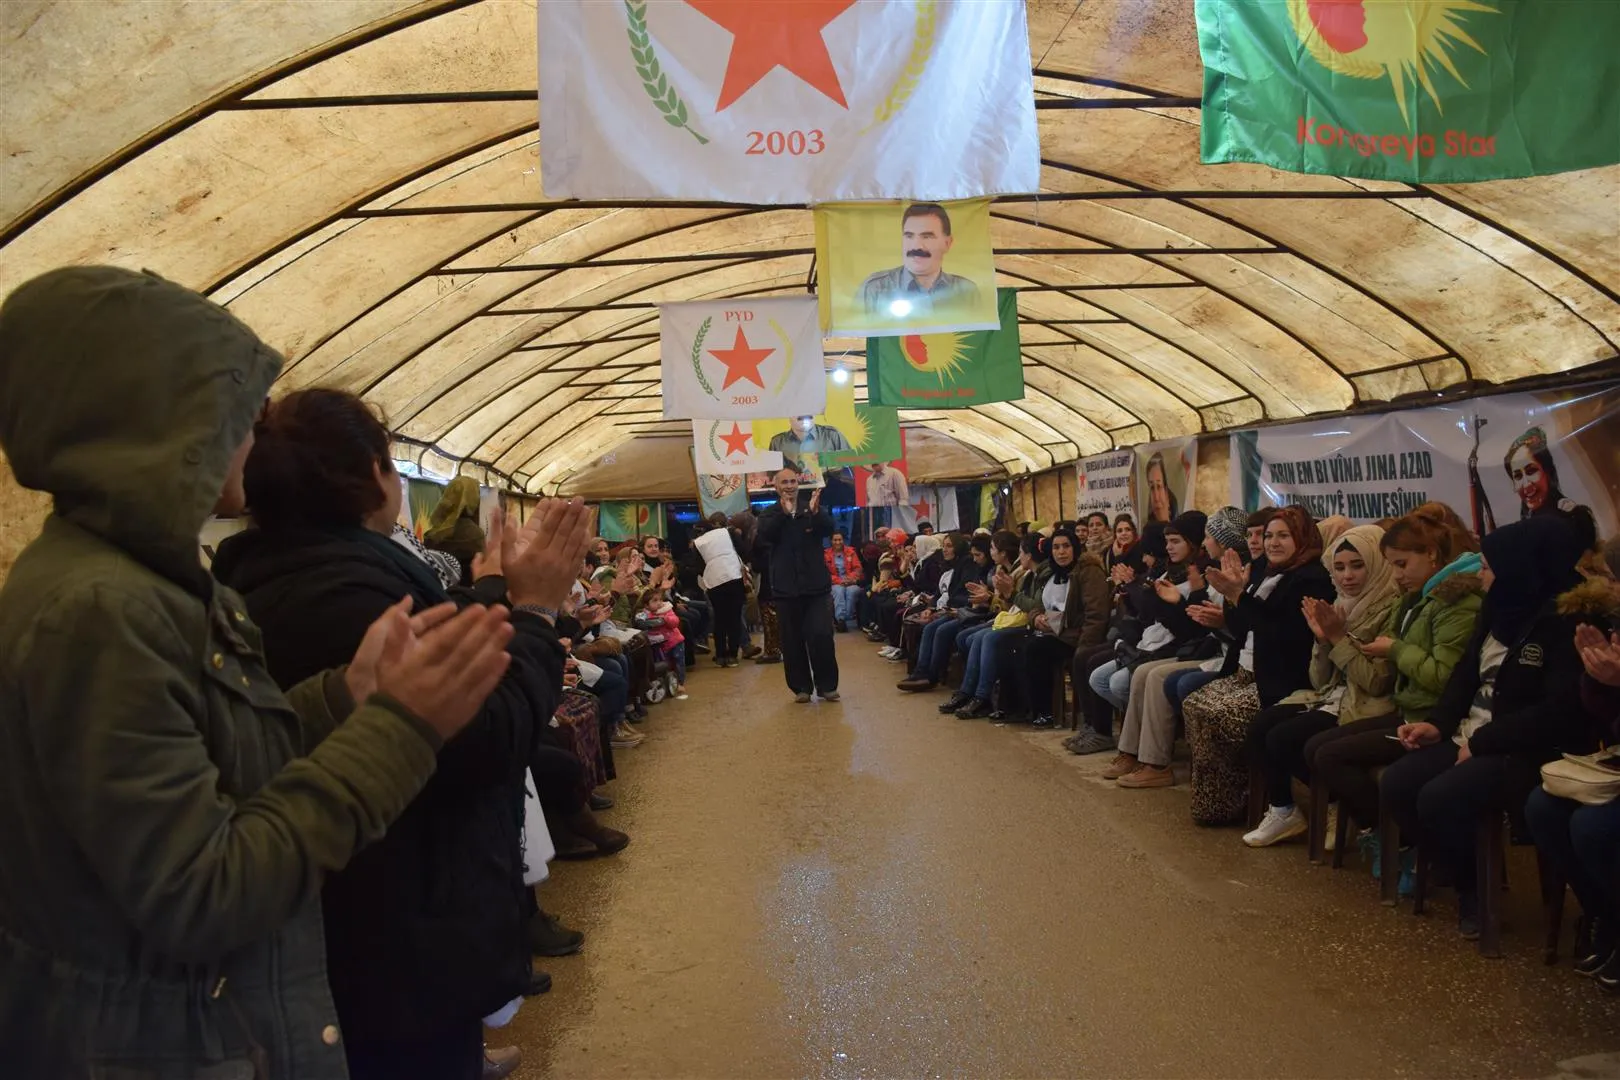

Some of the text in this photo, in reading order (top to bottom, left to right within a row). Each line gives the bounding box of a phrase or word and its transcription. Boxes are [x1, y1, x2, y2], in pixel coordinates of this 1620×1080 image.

[744, 129, 826, 156] 2003
[1296, 115, 1498, 162] Kongreya Star
[725, 310, 754, 322] PYD
[732, 395, 758, 405] 2003
[1297, 459, 1314, 485] EM
[1315, 458, 1329, 484] BI
[1329, 453, 1363, 483] VÎNA
[1365, 454, 1398, 482] JINA
[1399, 450, 1434, 480] AZAD
